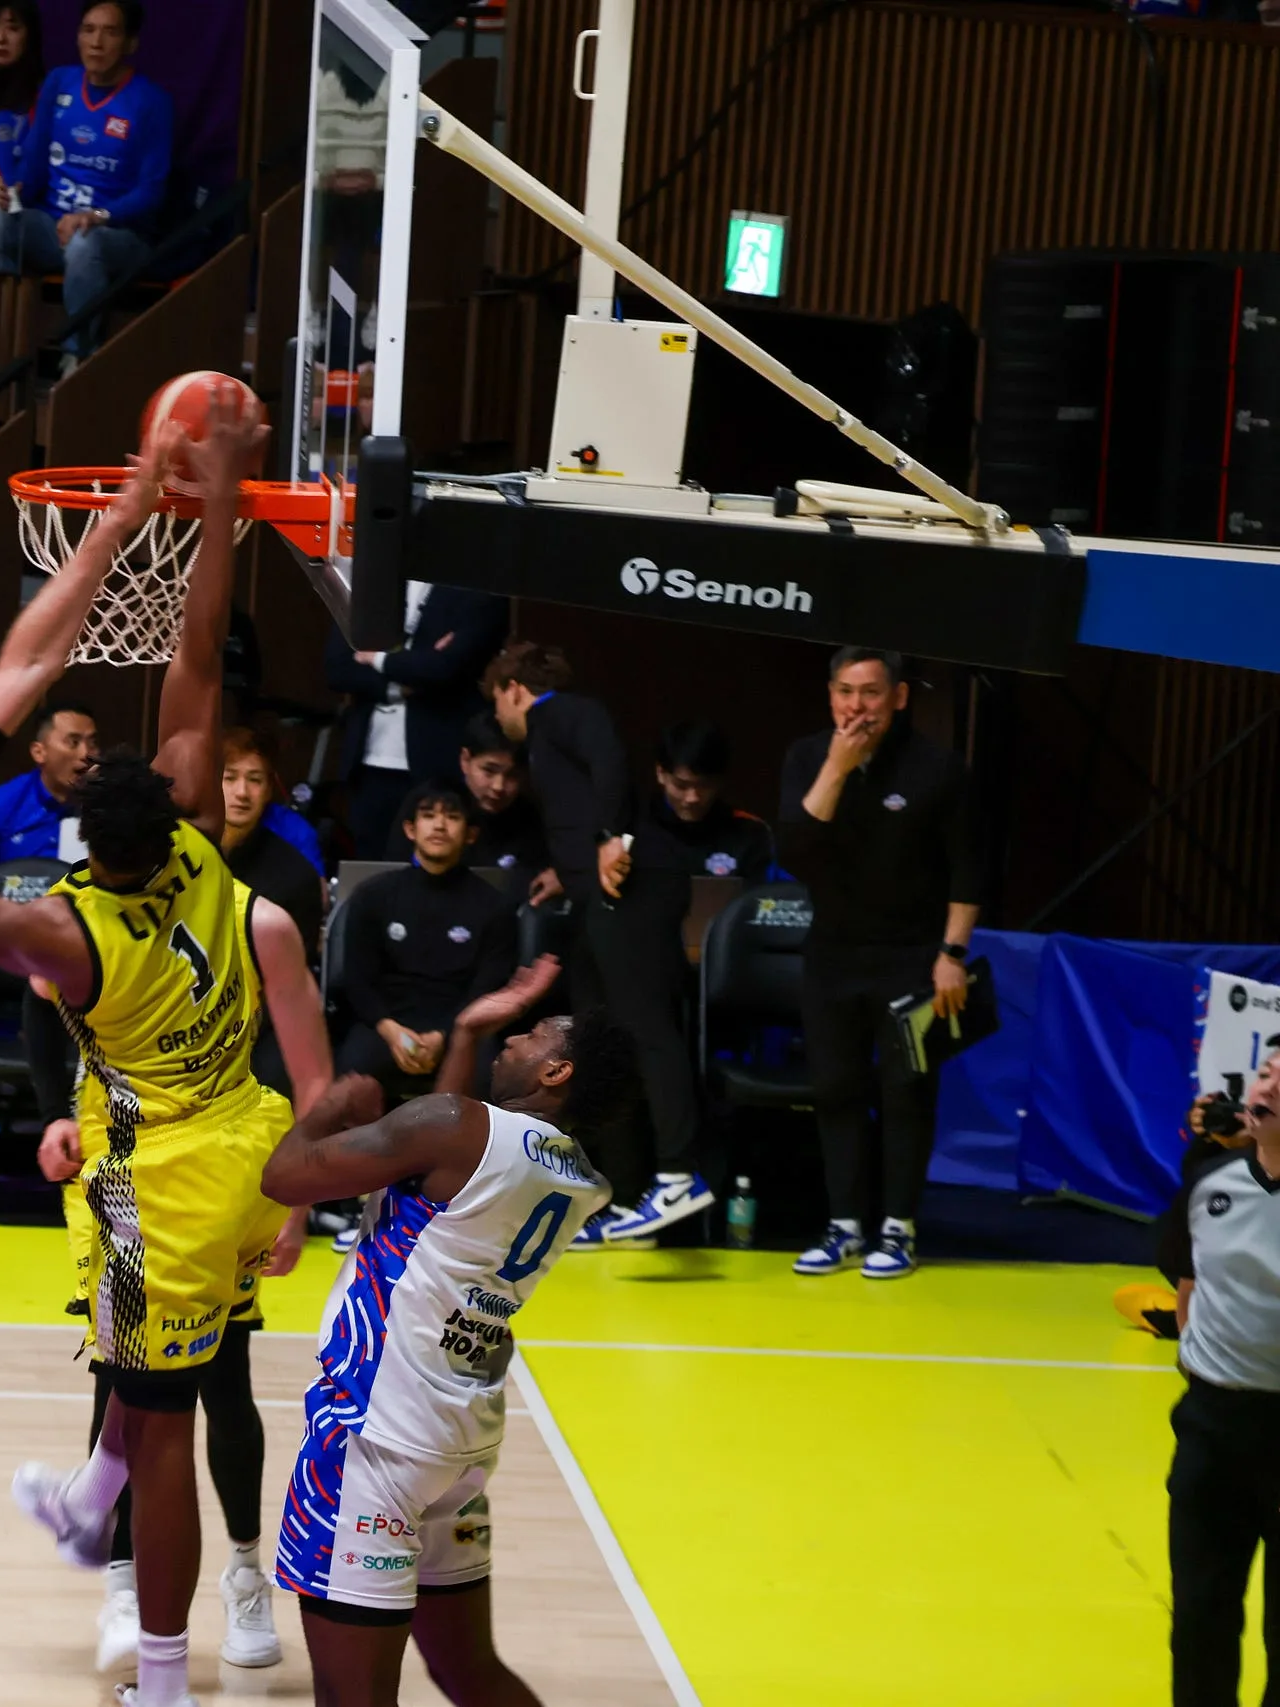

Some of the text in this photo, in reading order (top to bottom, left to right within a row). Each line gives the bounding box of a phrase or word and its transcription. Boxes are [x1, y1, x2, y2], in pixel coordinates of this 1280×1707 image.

[662, 568, 813, 614] Senoh
[167, 919, 217, 1007] 1
[157, 971, 242, 1054] GRANTHAM
[495, 1190, 573, 1283] 0
